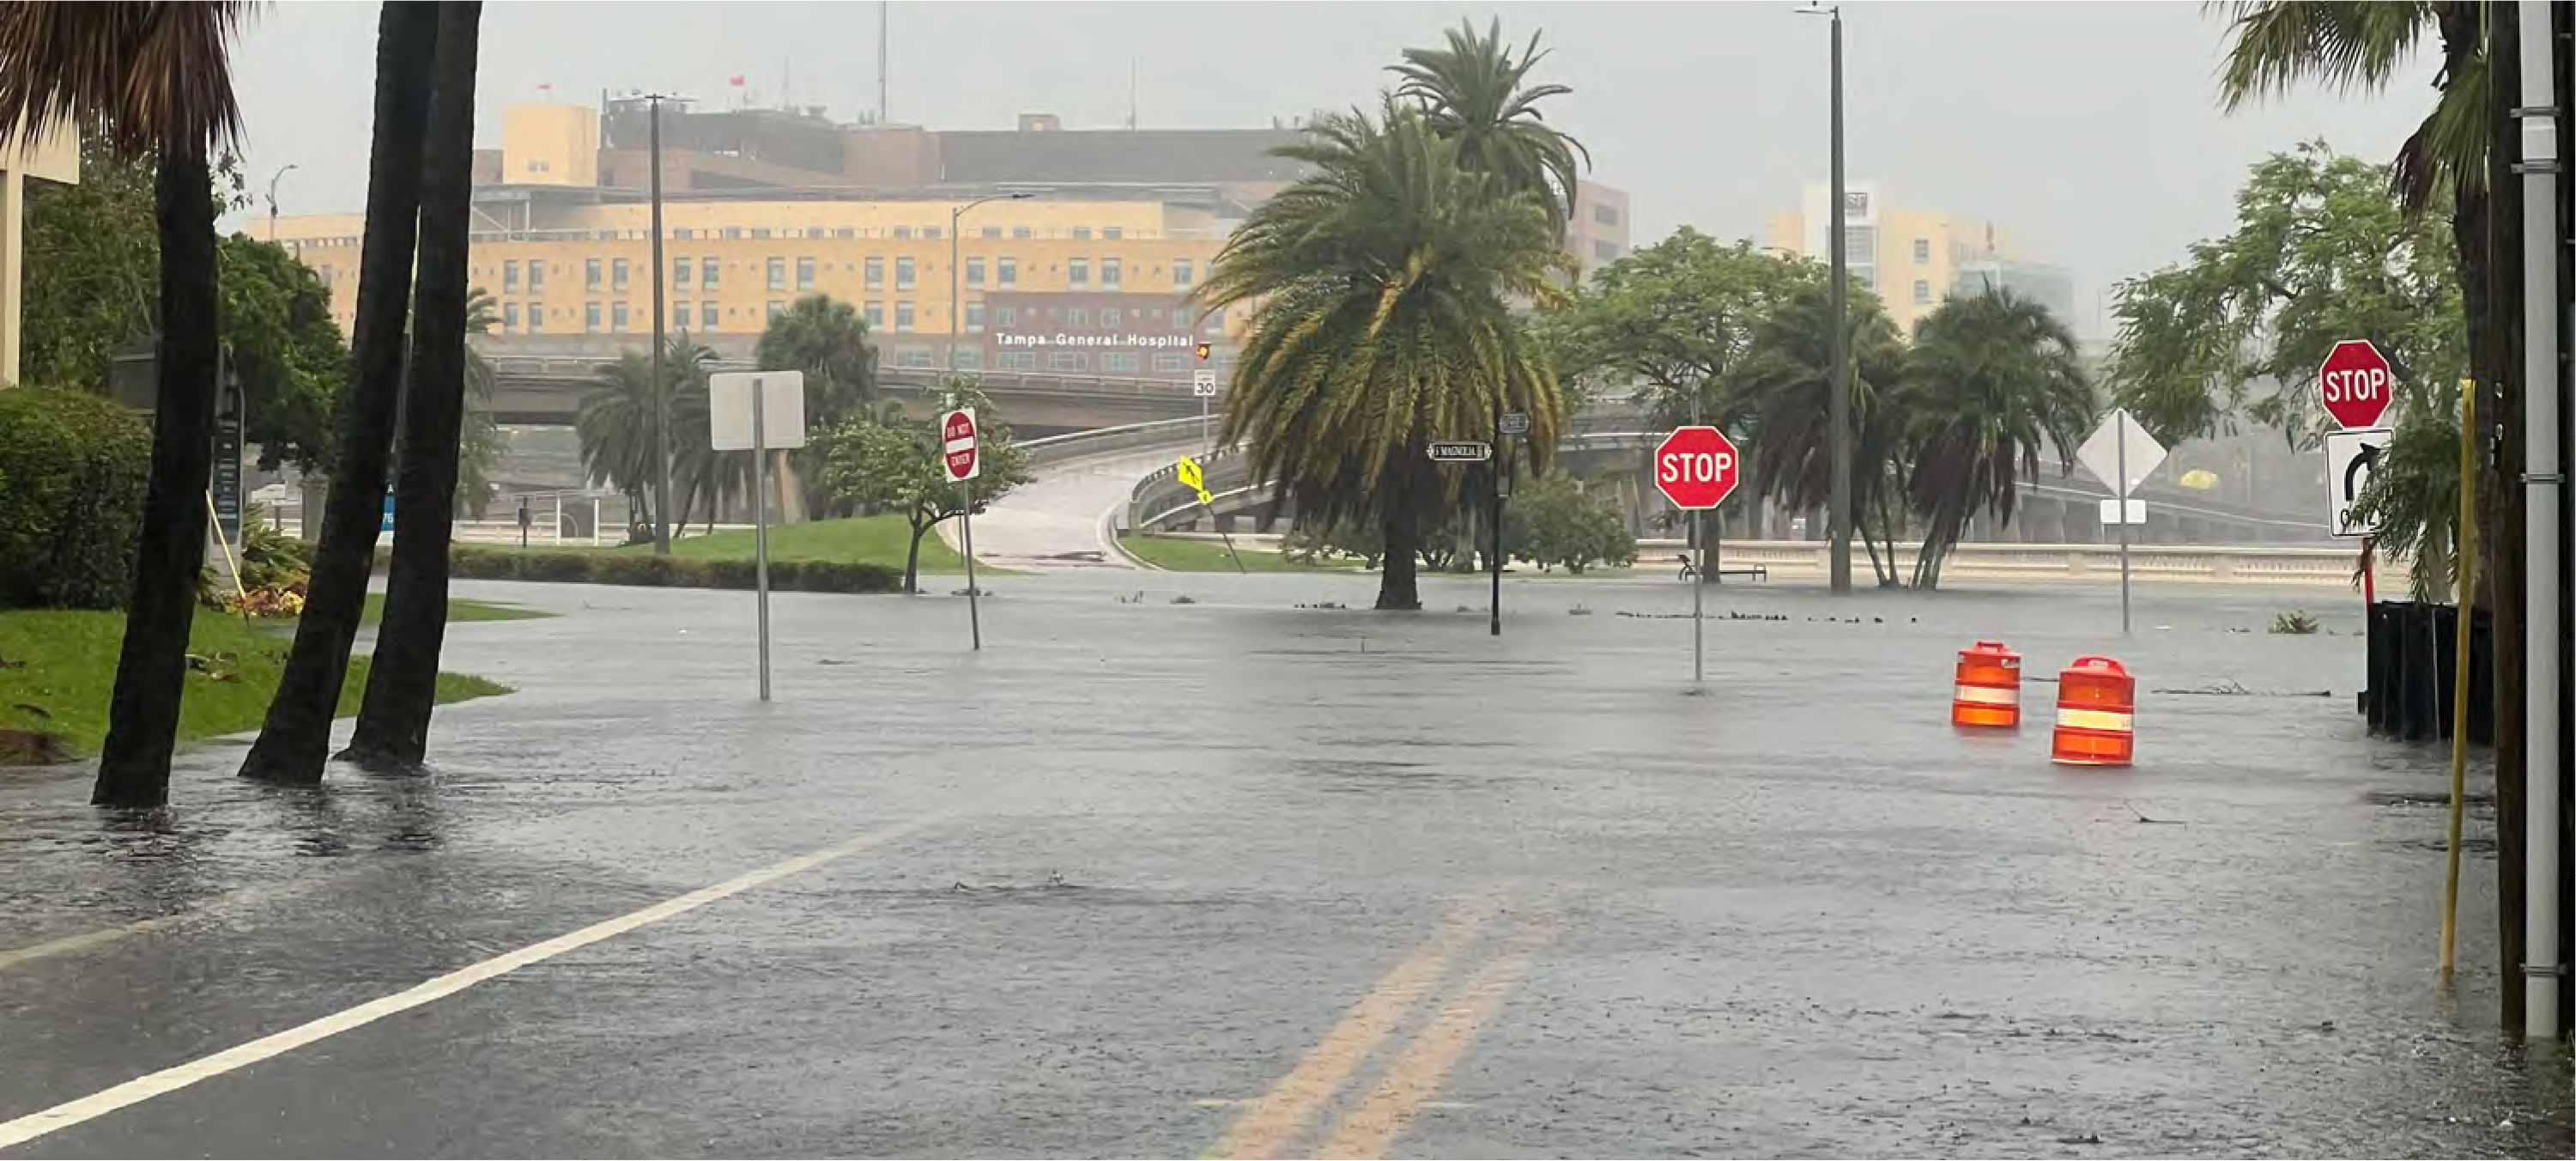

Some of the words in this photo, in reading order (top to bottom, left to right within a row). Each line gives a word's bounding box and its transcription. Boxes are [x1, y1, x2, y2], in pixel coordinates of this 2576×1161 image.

[996, 332, 1046, 348] Tampa
[1056, 332, 1118, 346] General
[1127, 334, 1194, 349] Hospital
[1197, 382, 1214, 393] 30
[2326, 368, 2386, 403] STOP
[1661, 453, 1732, 483] STOP
